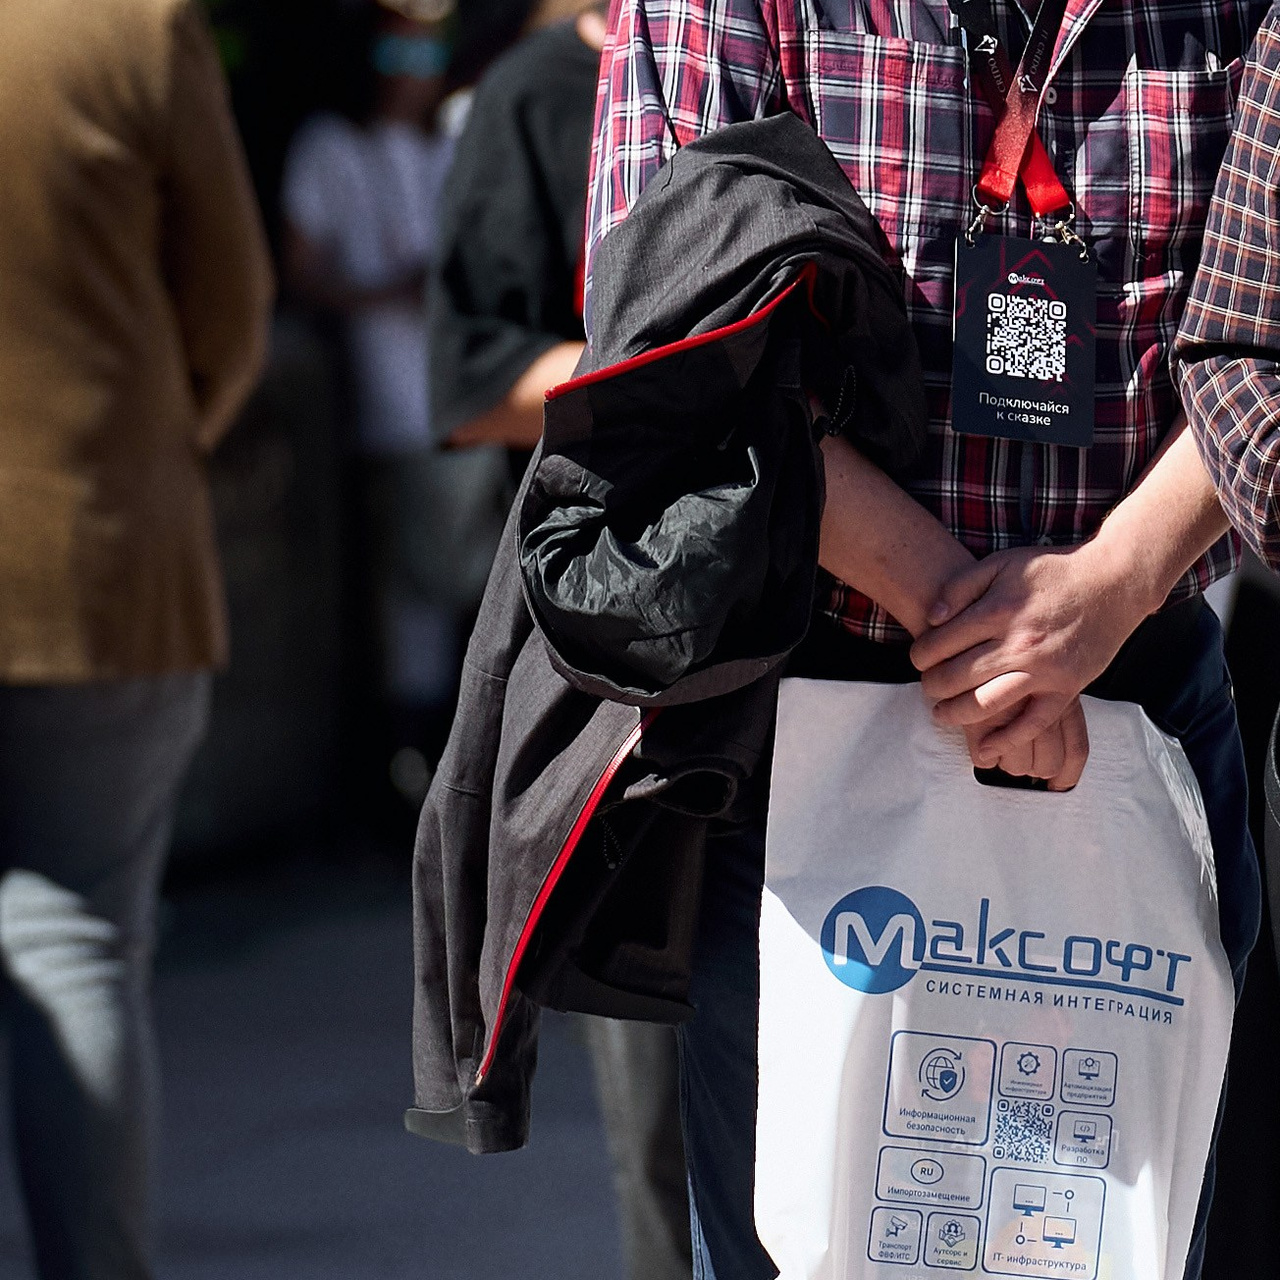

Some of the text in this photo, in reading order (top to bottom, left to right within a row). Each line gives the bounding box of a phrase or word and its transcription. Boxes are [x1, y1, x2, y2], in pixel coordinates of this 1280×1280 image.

[979, 392, 1070, 415] Подключайся
[1007, 411, 1051, 426] сказке
[826, 895, 1192, 994] Максофт
[925, 979, 1173, 1024] СИСТЕМНАЯ ИНТЕГРАЦИЯ
[899, 1107, 976, 1125] Информационная
[906, 1120, 966, 1136] безопасность
[1061, 1144, 1105, 1157] Разработка
[1076, 1155, 1089, 1165] ПО
[920, 1166, 934, 1177] RU
[887, 1185, 971, 1203] Импортозамещение
[878, 1239, 913, 1252] Транспорт
[933, 1246, 962, 1257] Аутсорс
[936, 1257, 962, 1267] сервис
[1006, 1253, 1087, 1272] инфраструктура
